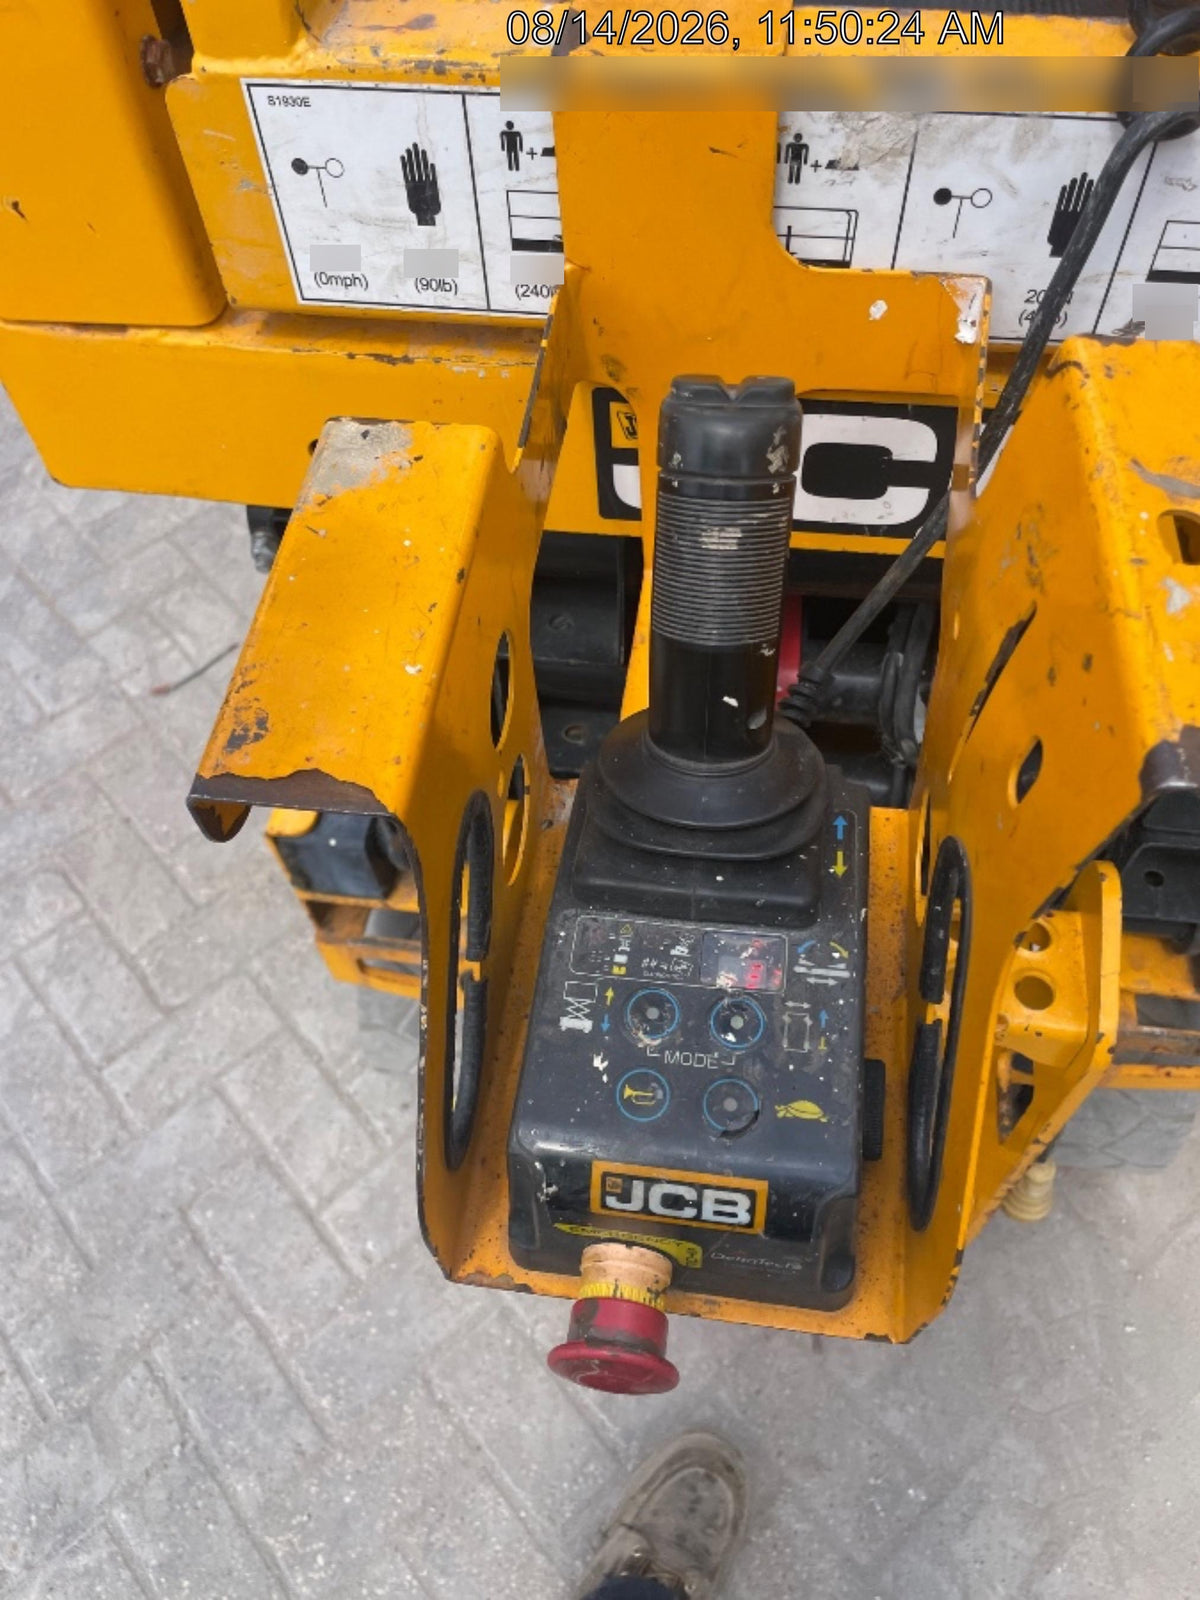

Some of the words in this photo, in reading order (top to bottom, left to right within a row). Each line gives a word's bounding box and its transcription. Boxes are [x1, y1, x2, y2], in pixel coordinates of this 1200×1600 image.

[267, 95, 312, 108] S1930E
[314, 272, 369, 290] (0mph)
[415, 277, 458, 296] (90lb)
[515, 284, 559, 301] (240l
[664, 1050, 719, 1069] MODE
[605, 1180, 752, 1226] JCB
